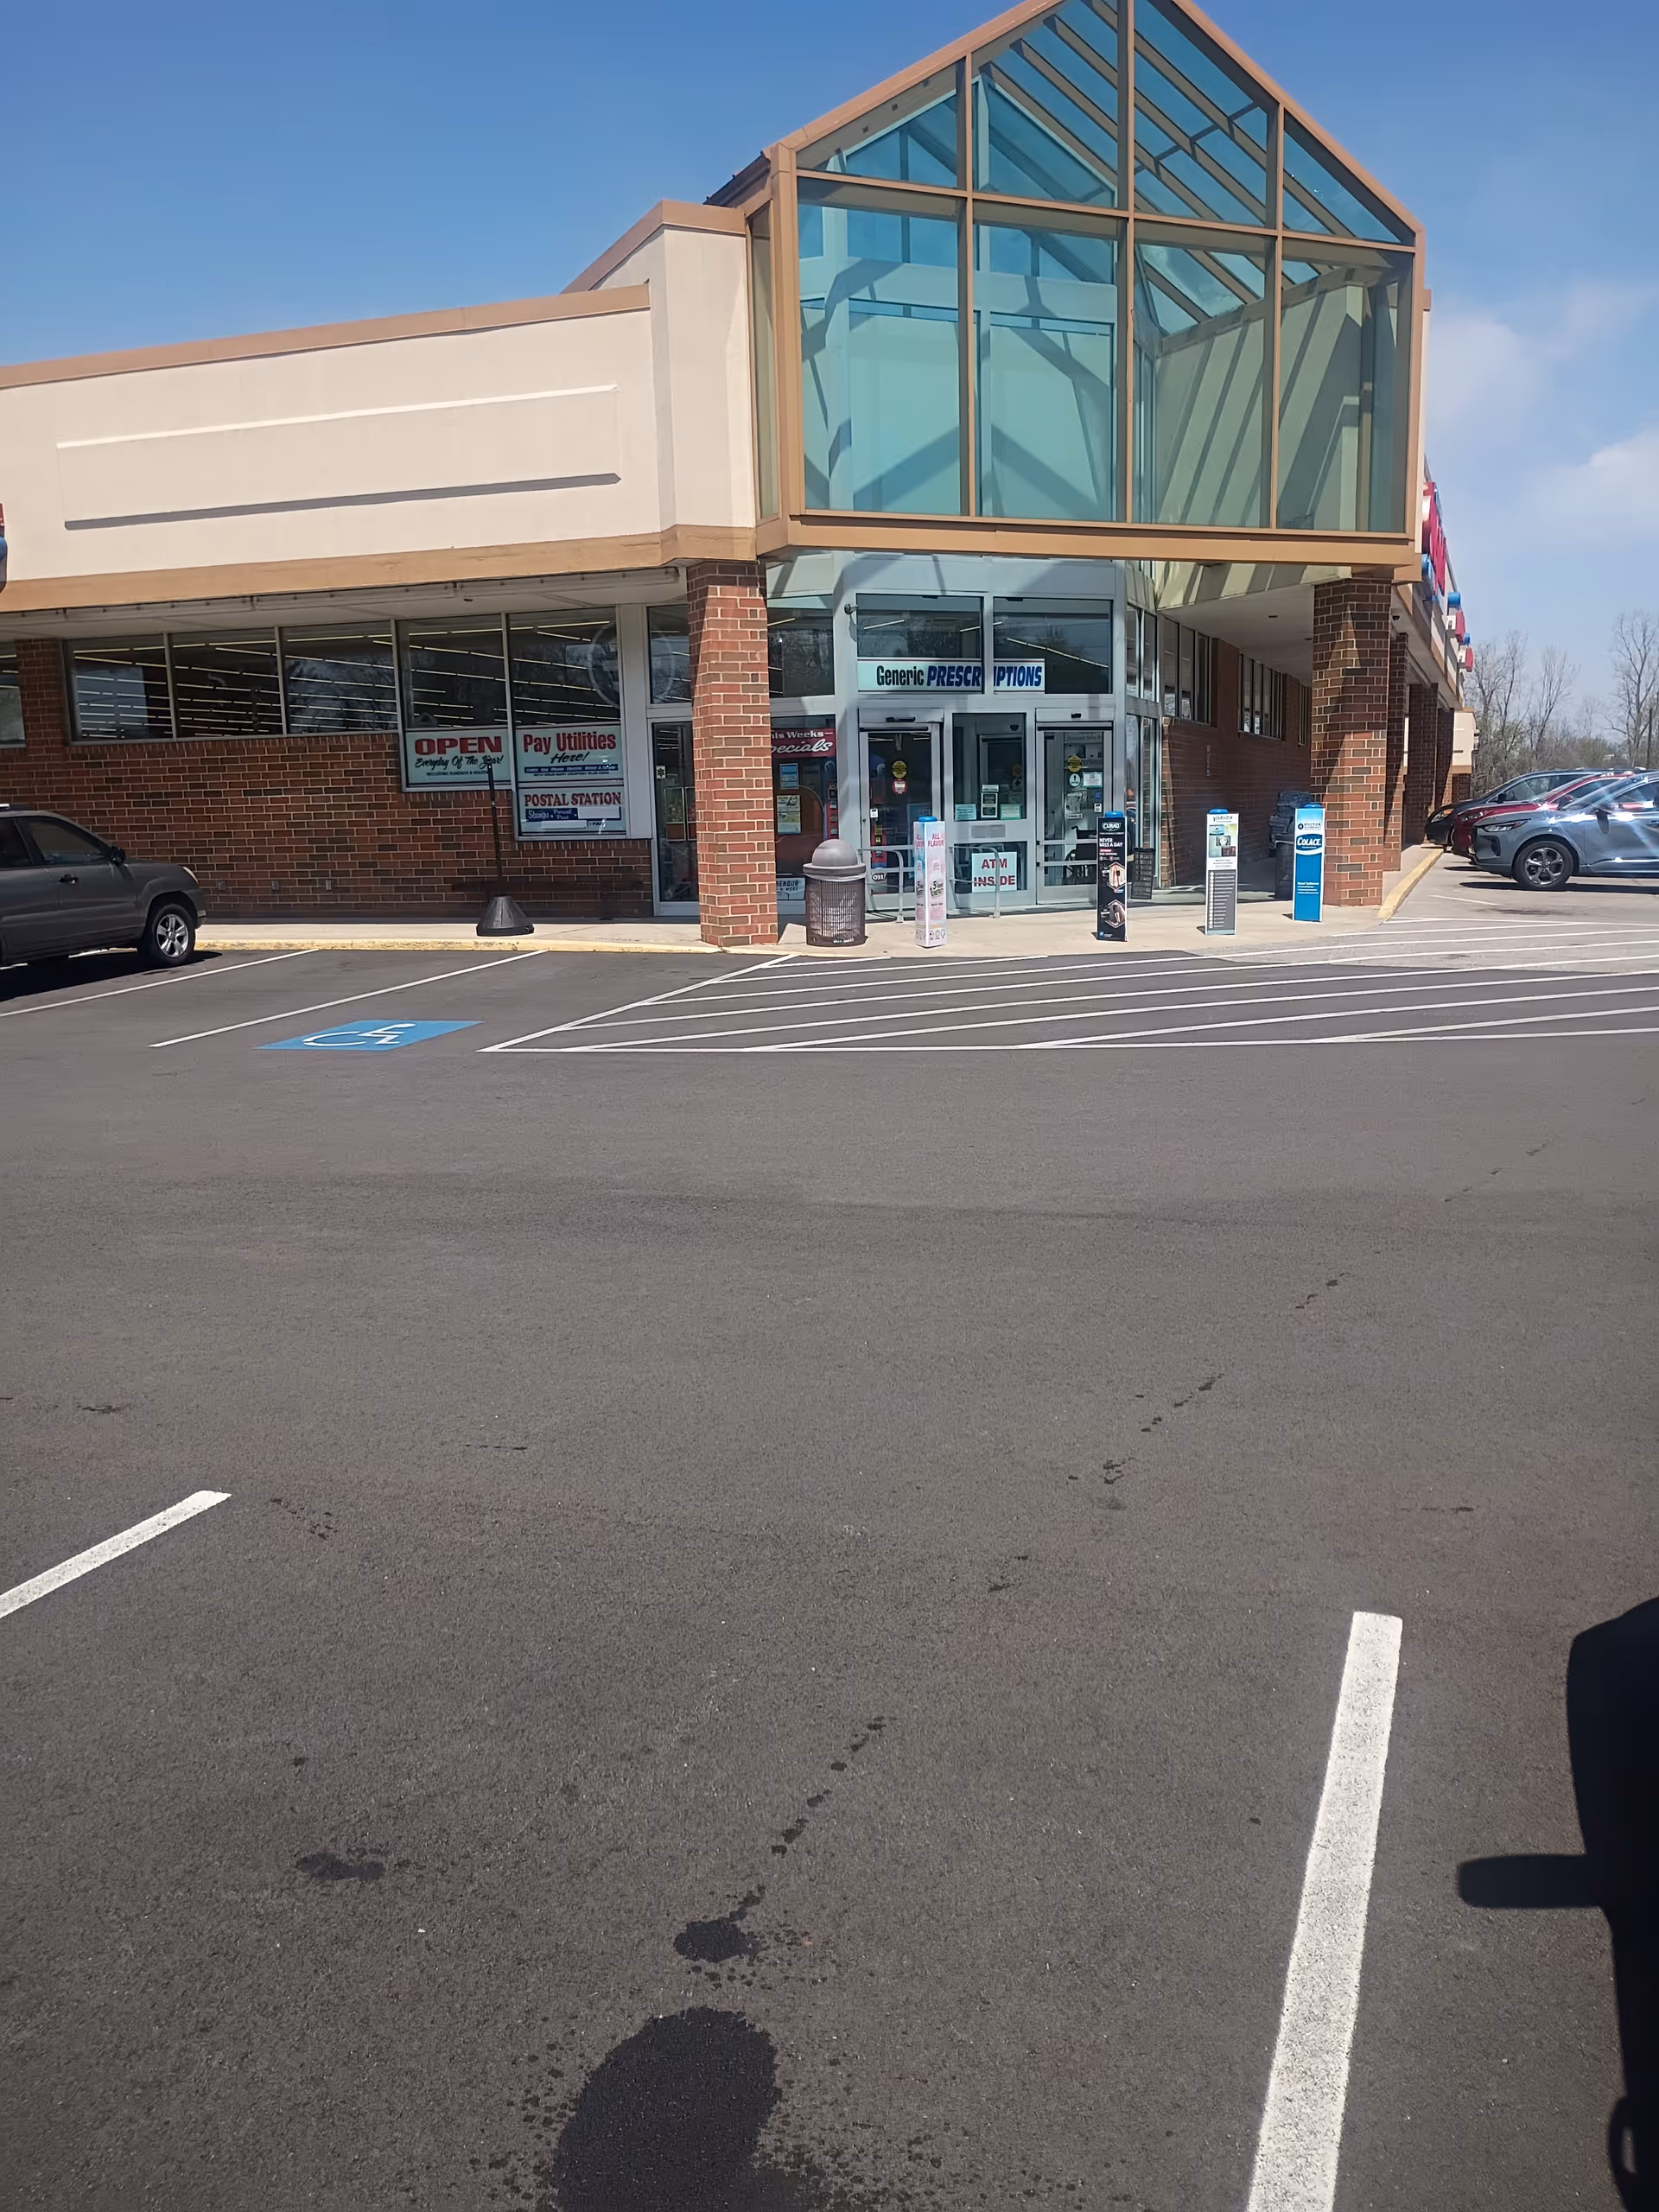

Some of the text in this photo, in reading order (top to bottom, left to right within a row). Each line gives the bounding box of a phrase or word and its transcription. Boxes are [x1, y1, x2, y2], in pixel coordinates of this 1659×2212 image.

[876, 665, 925, 686] Generic
[786, 730, 824, 739] Weeks
[415, 735, 503, 755] OPEN
[523, 731, 617, 755] Pay Utilities
[415, 757, 449, 770] Everyday
[451, 756, 463, 769] Of
[465, 755, 478, 766] The
[550, 752, 590, 764] Here!
[524, 792, 621, 807] POSTAL STATION
[1297, 836, 1322, 846] COLACE
[982, 858, 1007, 869] ATM
[974, 875, 1015, 887] INSDE
